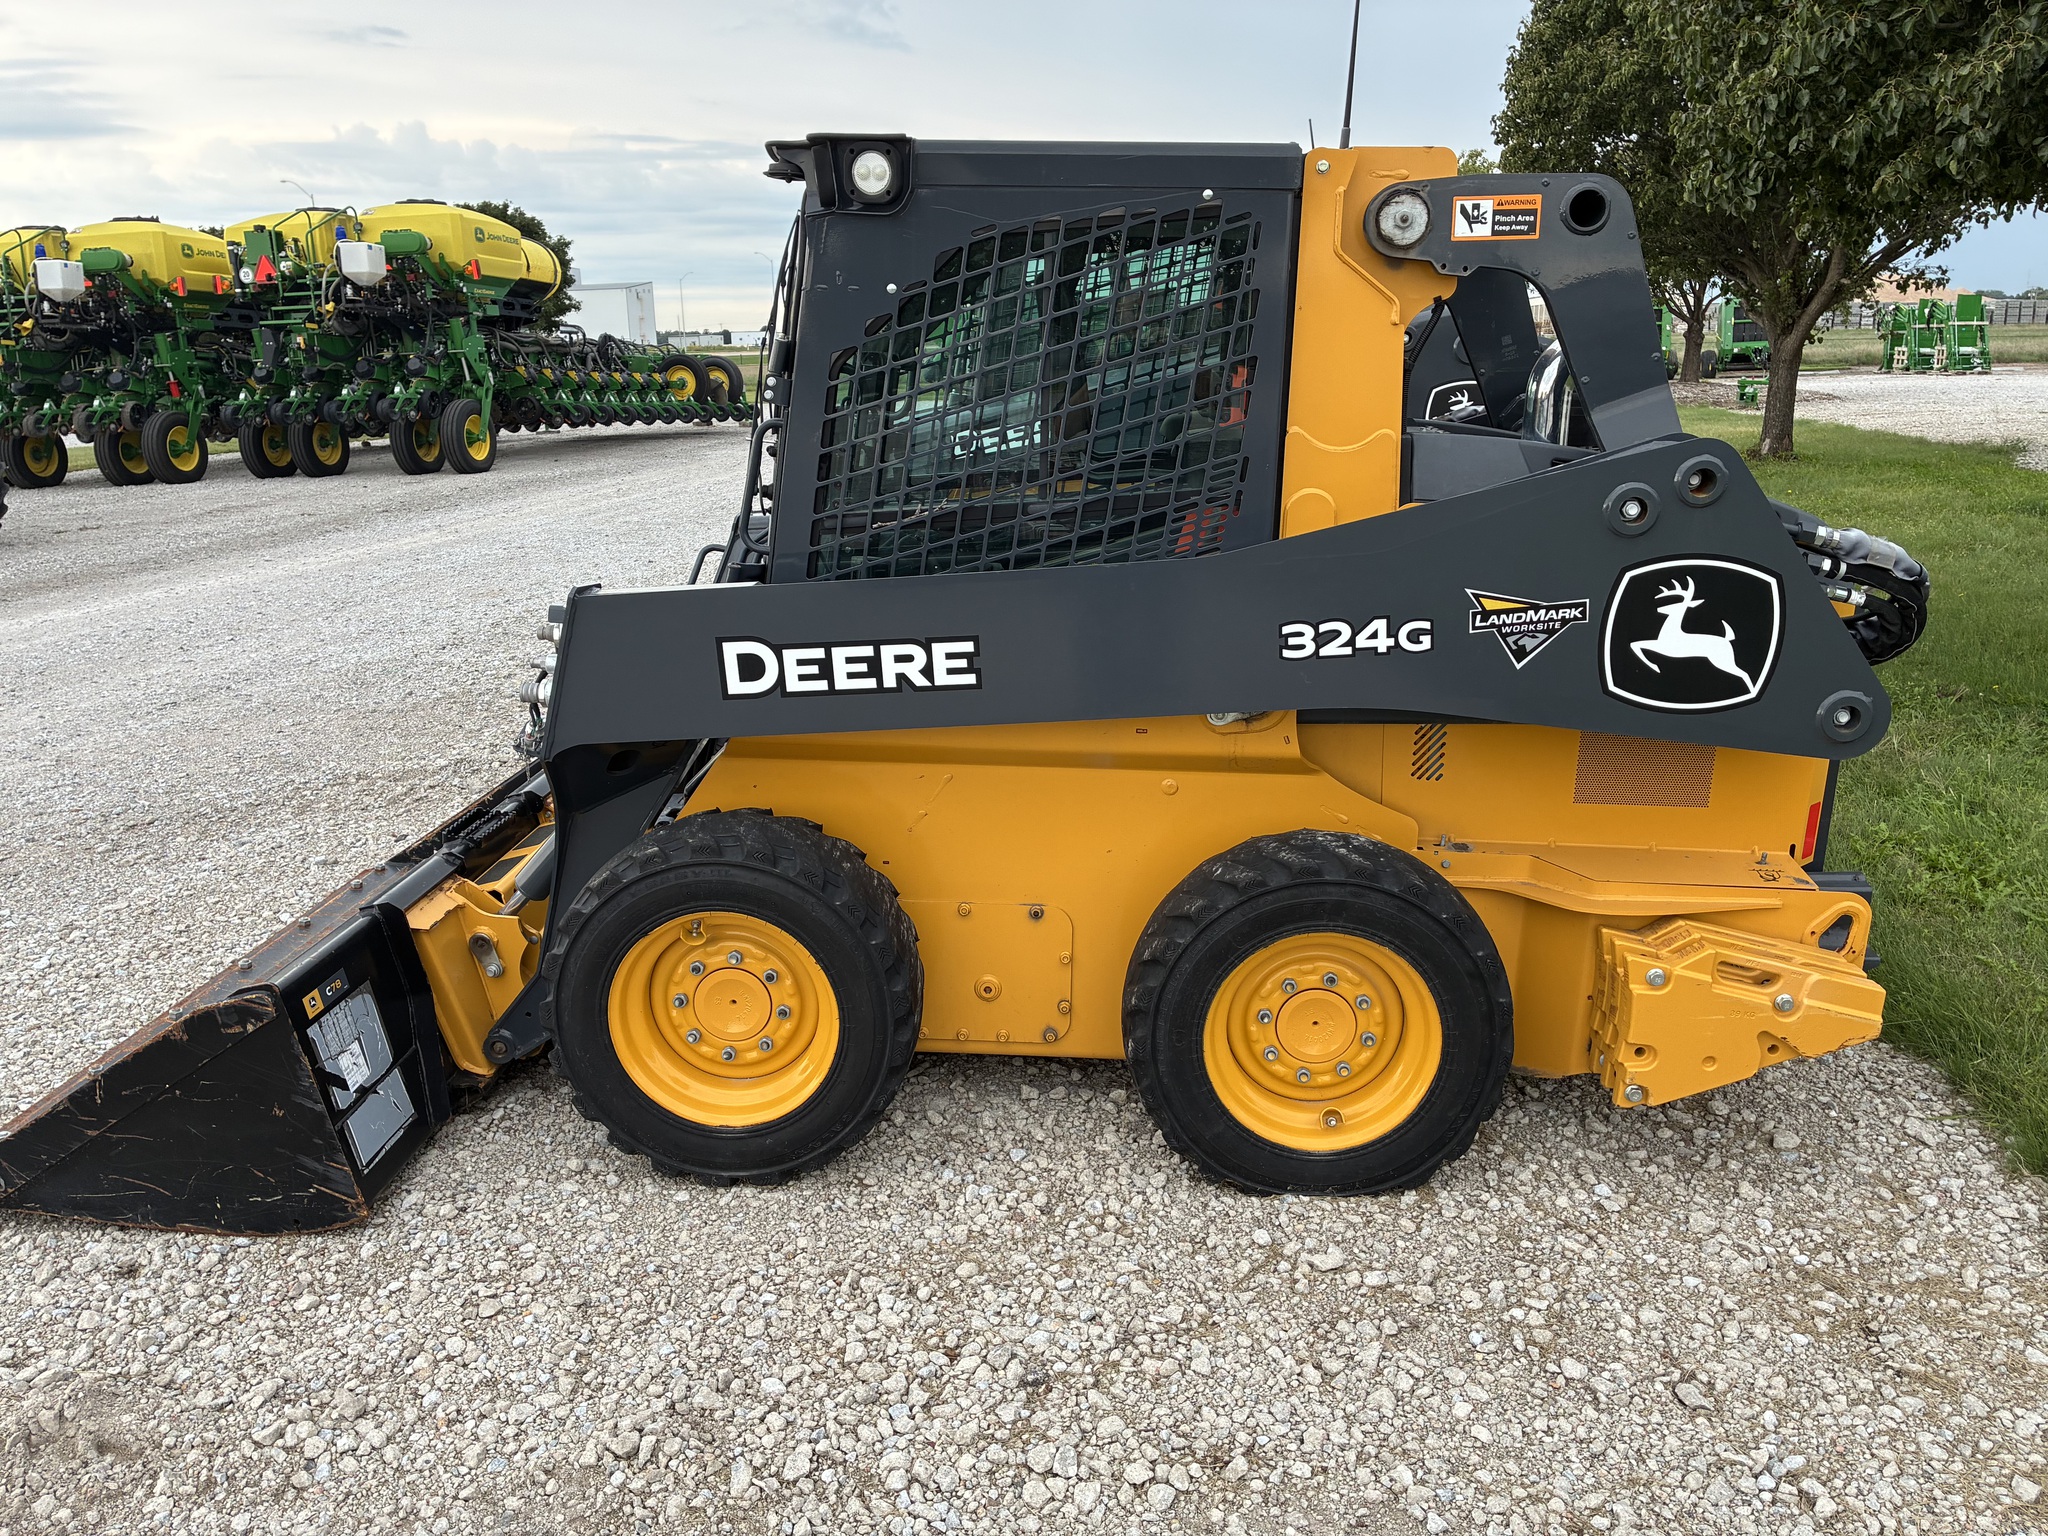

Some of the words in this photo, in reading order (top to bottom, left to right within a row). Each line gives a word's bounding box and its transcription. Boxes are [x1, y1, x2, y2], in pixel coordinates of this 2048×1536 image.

[1518, 214, 1535, 222] Area
[1494, 224, 1510, 232] Keep
[487, 232, 502, 241] JOHN
[502, 234, 519, 245] DEERE
[196, 248, 215, 257] JOHN
[243, 270, 250, 278] 20
[1501, 621, 1562, 634] WORKSITE
[1281, 618, 1432, 660] 324G
[720, 640, 978, 696] DEERE
[325, 979, 342, 996] C78
